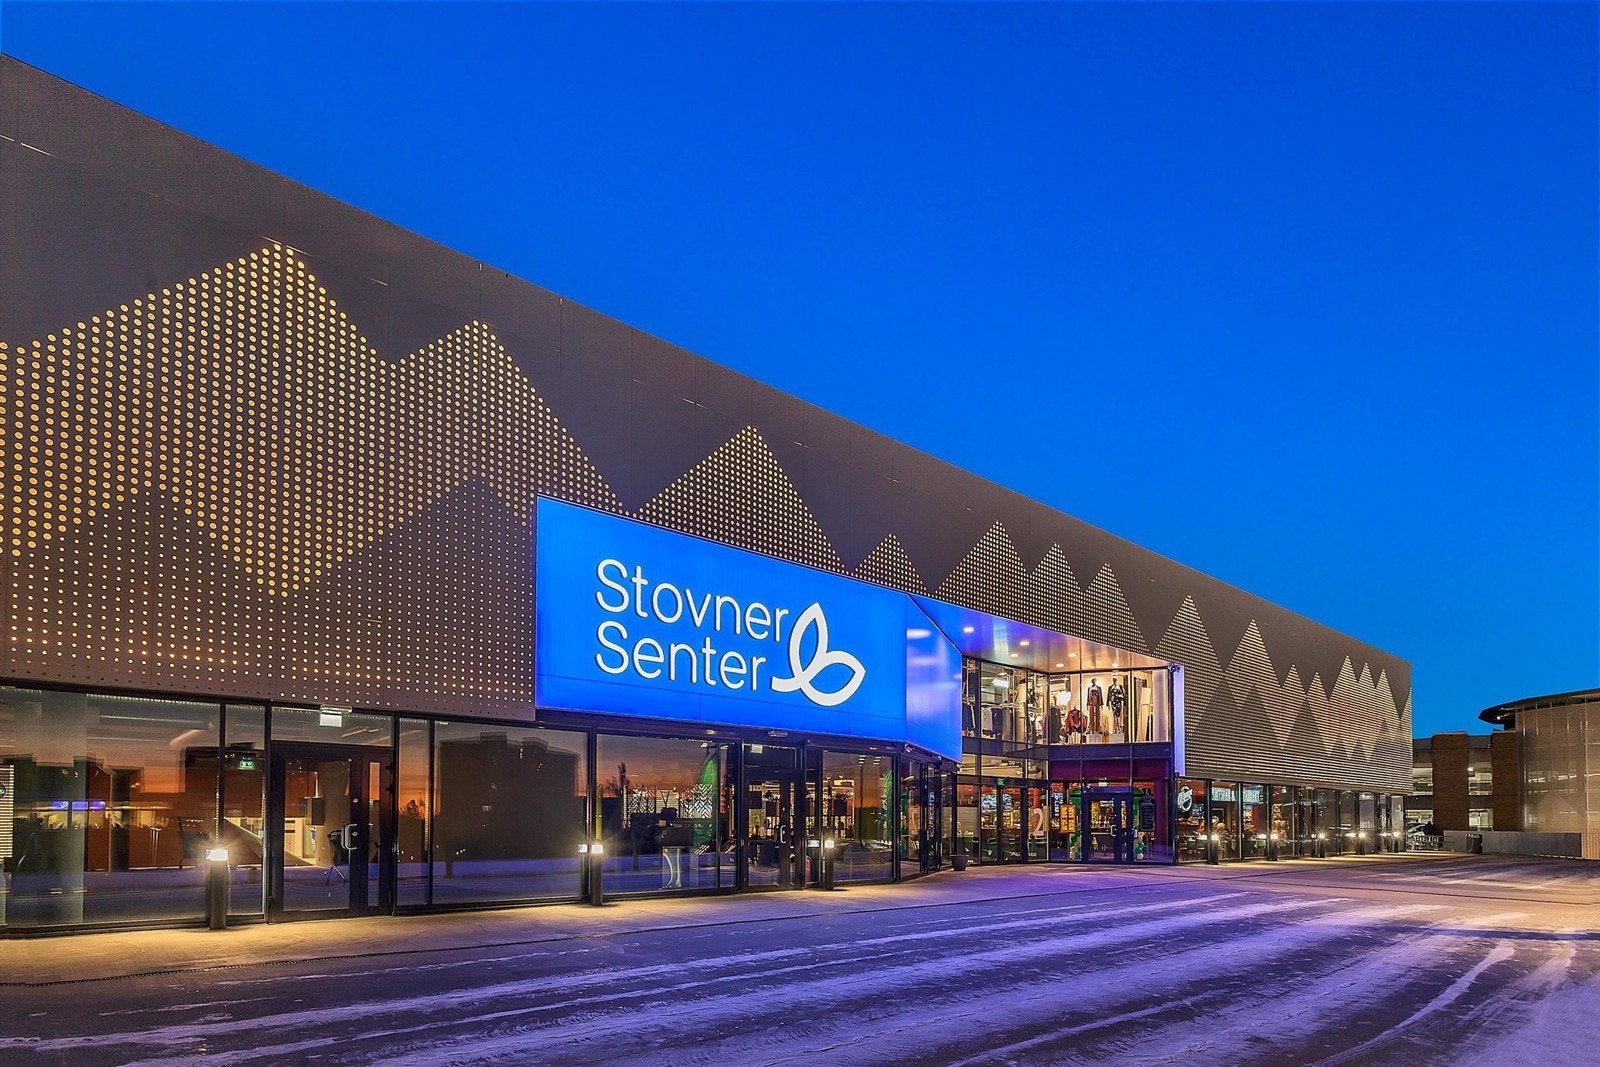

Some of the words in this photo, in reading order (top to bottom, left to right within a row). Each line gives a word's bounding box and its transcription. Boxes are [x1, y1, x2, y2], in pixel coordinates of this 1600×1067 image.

[596, 558, 789, 642] Stovner
[596, 620, 767, 691] Senter
[1033, 807, 1044, 836] 2
